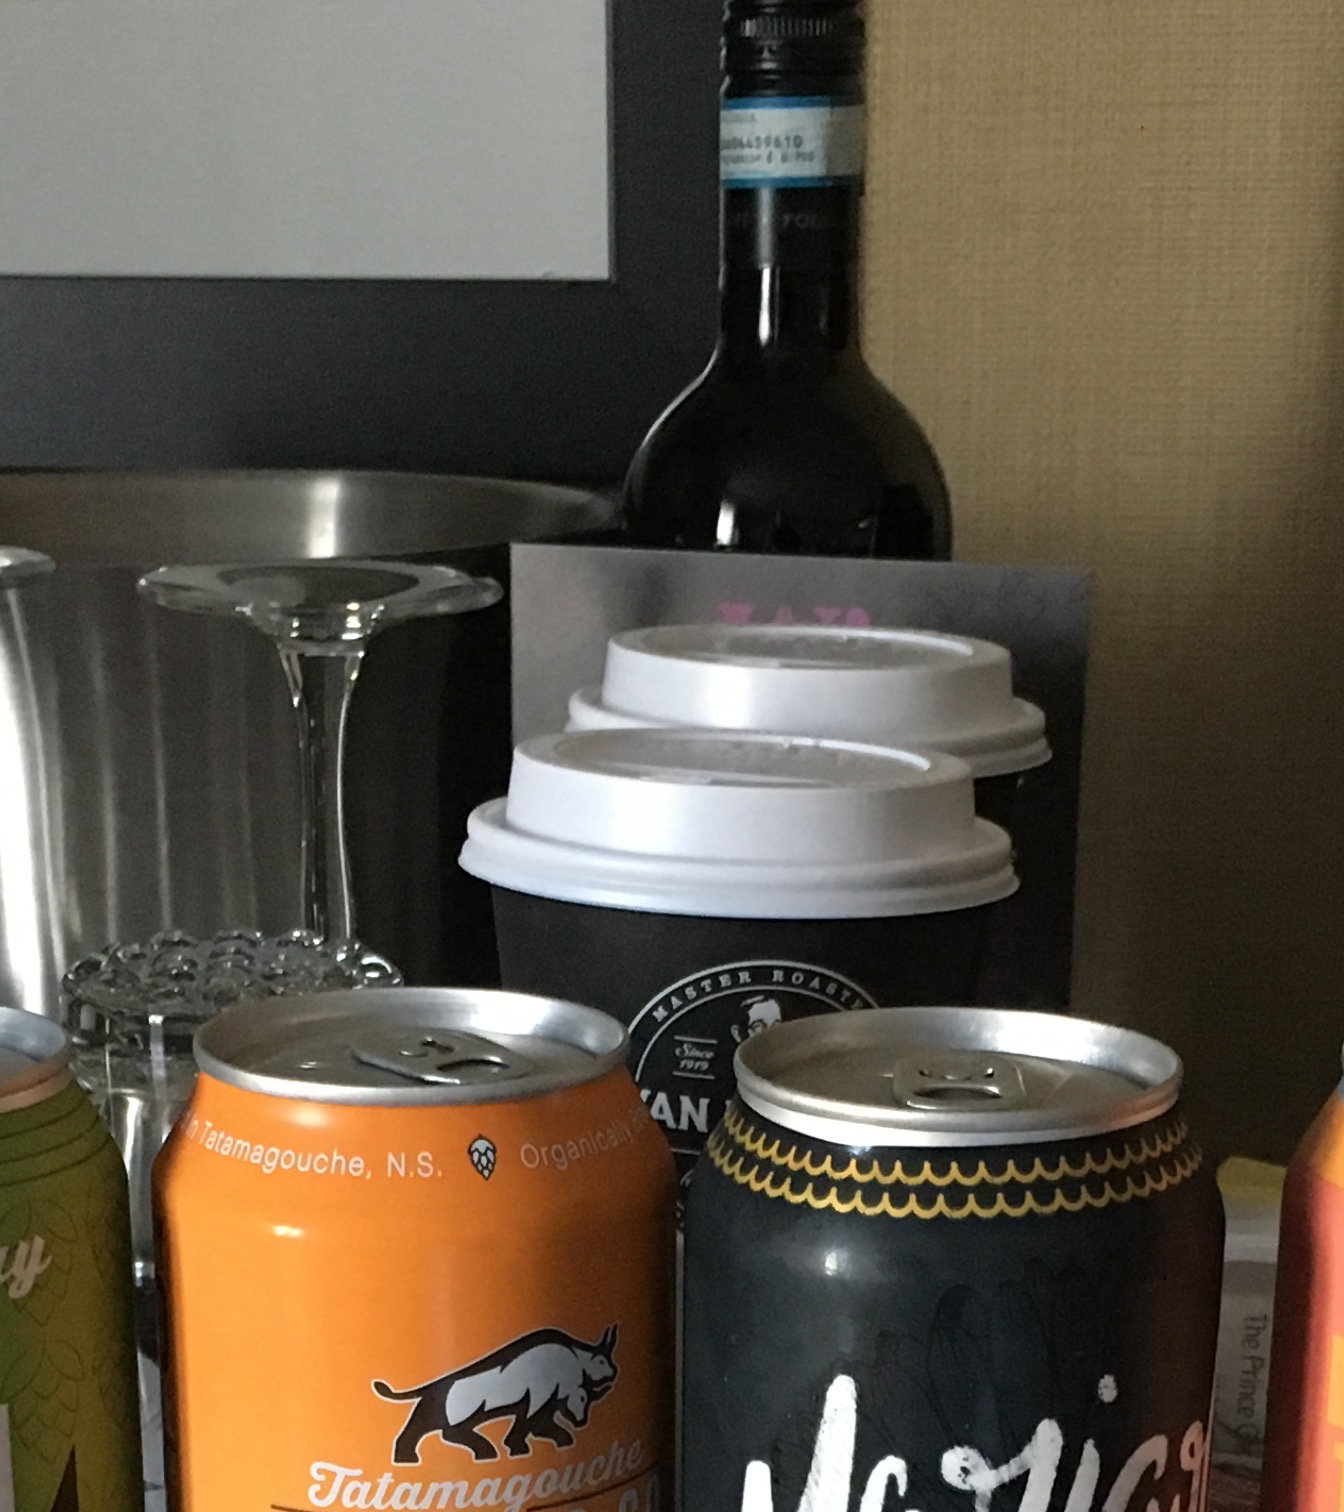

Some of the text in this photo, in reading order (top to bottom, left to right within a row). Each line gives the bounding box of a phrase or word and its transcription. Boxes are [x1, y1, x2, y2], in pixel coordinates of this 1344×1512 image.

[652, 969, 752, 1023] MASTER
[674, 1042, 716, 1060] Since
[678, 1057, 710, 1072] 1919
[199, 1119, 373, 1180] Tatamagouche,
[386, 1151, 444, 1179] N.S.
[520, 1119, 634, 1171] Organically
